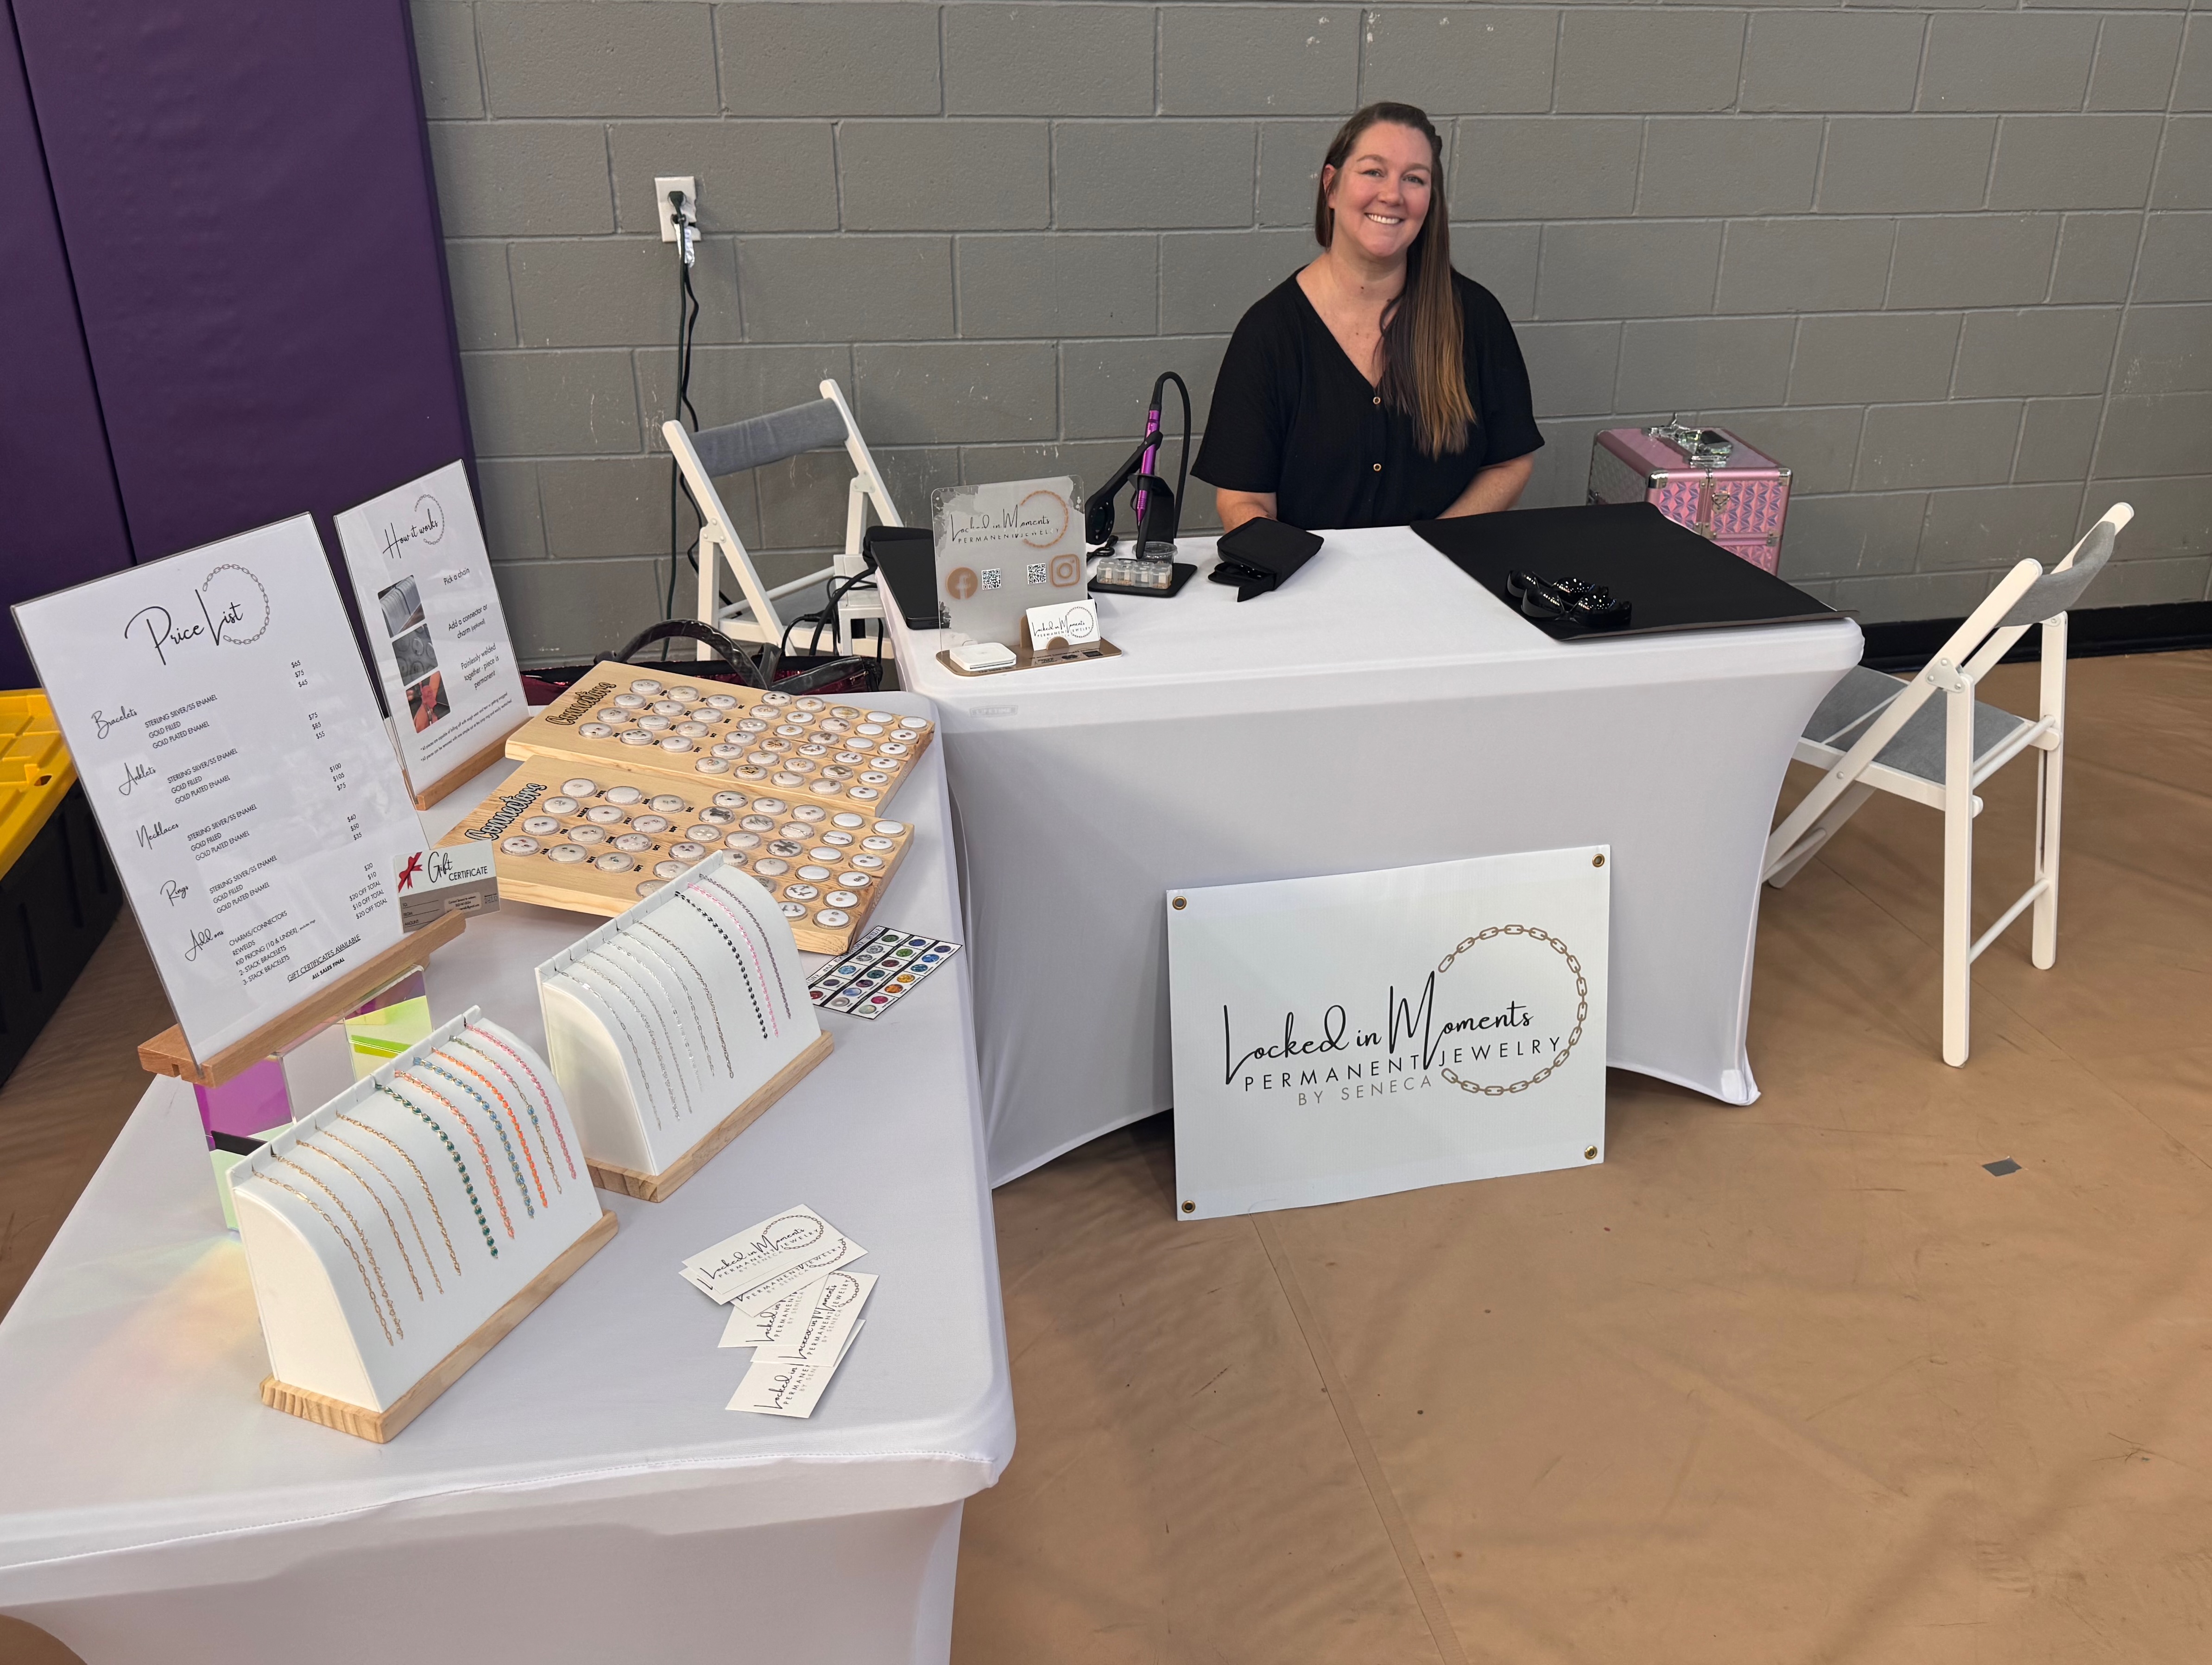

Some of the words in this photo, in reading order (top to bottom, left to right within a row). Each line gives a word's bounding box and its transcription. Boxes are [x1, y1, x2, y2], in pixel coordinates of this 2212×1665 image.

[383, 523, 410, 559] How
[411, 525, 418, 537] it
[419, 508, 438, 534] works
[1003, 504, 1049, 538] Moments
[443, 575, 453, 585] Pick
[458, 568, 470, 578] chain
[125, 606, 204, 665] Price
[195, 589, 243, 646] List
[449, 620, 458, 631] Add
[462, 608, 482, 623] connector
[457, 626, 471, 639] charm
[461, 654, 480, 670] Painlessly
[481, 643, 496, 656] welded
[464, 665, 481, 681] together
[483, 659, 495, 670] piece
[295, 669, 304, 678] $75
[298, 679, 308, 687] $45
[474, 671, 495, 690] permanent
[145, 714, 170, 728] STERLING
[171, 703, 196, 718] SILVER/SS
[196, 694, 217, 708] ENAMEL
[545, 682, 617, 725] Connectors
[91, 706, 137, 739] Bracelets
[149, 728, 164, 738] GOLD
[165, 721, 181, 732] FILLED
[152, 738, 168, 749] GOLD
[169, 731, 187, 742] PLATED
[188, 721, 209, 734] ENAMEL
[119, 763, 156, 795] Anklets
[167, 769, 191, 783] STERLING
[192, 758, 216, 773] SILVER/SS
[217, 749, 238, 762] ENAMEL
[330, 763, 341, 772] $100
[333, 773, 345, 782] $105
[171, 783, 186, 794] GOLD
[187, 776, 202, 787] FILLED
[175, 794, 190, 804] GOLD
[191, 785, 209, 797] PLATED
[209, 776, 230, 788] ENAMEL
[337, 782, 346, 791] $75
[188, 826, 211, 841] STERLING
[212, 814, 236, 829] SILVER/SS
[236, 804, 257, 818] ENAMEL
[465, 783, 547, 841] Connectors
[136, 822, 179, 850] Necklaces
[191, 840, 206, 851] GOLD
[207, 832, 221, 844] FILLED
[196, 850, 210, 860] GOLD
[211, 841, 228, 853] PLATED
[229, 831, 249, 844] ENAMEL
[354, 832, 362, 840] $35
[209, 879, 233, 894] STERLING
[233, 866, 257, 881] SILVER/SS
[257, 855, 277, 869] ENAMEL
[428, 851, 453, 883] Gift
[449, 866, 487, 881] CERTIFICATE
[160, 880, 189, 906] Rings
[213, 893, 228, 903] GOLD
[228, 885, 243, 896] FILLED
[217, 903, 232, 913] GOLD
[232, 893, 249, 906] PLATED
[250, 882, 270, 896] ENAMEL
[367, 881, 381, 890] TOTAL
[371, 889, 384, 899] TOTAL
[356, 911, 365, 919] $20
[365, 905, 374, 914] OFF
[374, 898, 387, 908] TOTAL
[229, 911, 287, 946] CHARMS/CONNECTORS
[185, 928, 213, 961] Add
[233, 940, 256, 956] REWELDS
[245, 946, 265, 962] PRICING
[245, 960, 259, 972] STACK
[260, 945, 286, 963] BRACELETS
[288, 970, 300, 983] GIFT
[300, 950, 334, 976] CERTIFICATES
[335, 934, 361, 956] AVAILABLE
[248, 970, 263, 982] STACK
[264, 954, 290, 972] BRACELETS
[320, 965, 332, 975] SALES
[332, 958, 345, 968] FINAL
[1224, 1005, 1349, 1085] Locked
[1356, 1029, 1381, 1048] in
[1389, 970, 1534, 1070] Moments
[1245, 1054, 1421, 1092] PERMANENT
[1439, 1037, 1561, 1067] JEWELRY
[1298, 1090, 1324, 1106] BY
[1341, 1075, 1432, 1101] SENECA
[700, 1252, 746, 1279] Locked
[750, 1228, 804, 1251] Moments
[718, 1249, 775, 1278] PERMANENT
[780, 1229, 818, 1248] JEWELRY
[752, 1250, 784, 1266] SENECA
[746, 1267, 799, 1300] PERMANENT
[779, 1269, 808, 1286] SENECA
[746, 1312, 777, 1342] Locked
[807, 1312, 834, 1355] PERMANENT
[832, 1280, 850, 1308] JEWELRY
[827, 1310, 842, 1331] SENECA
[754, 1375, 792, 1409] Locked
